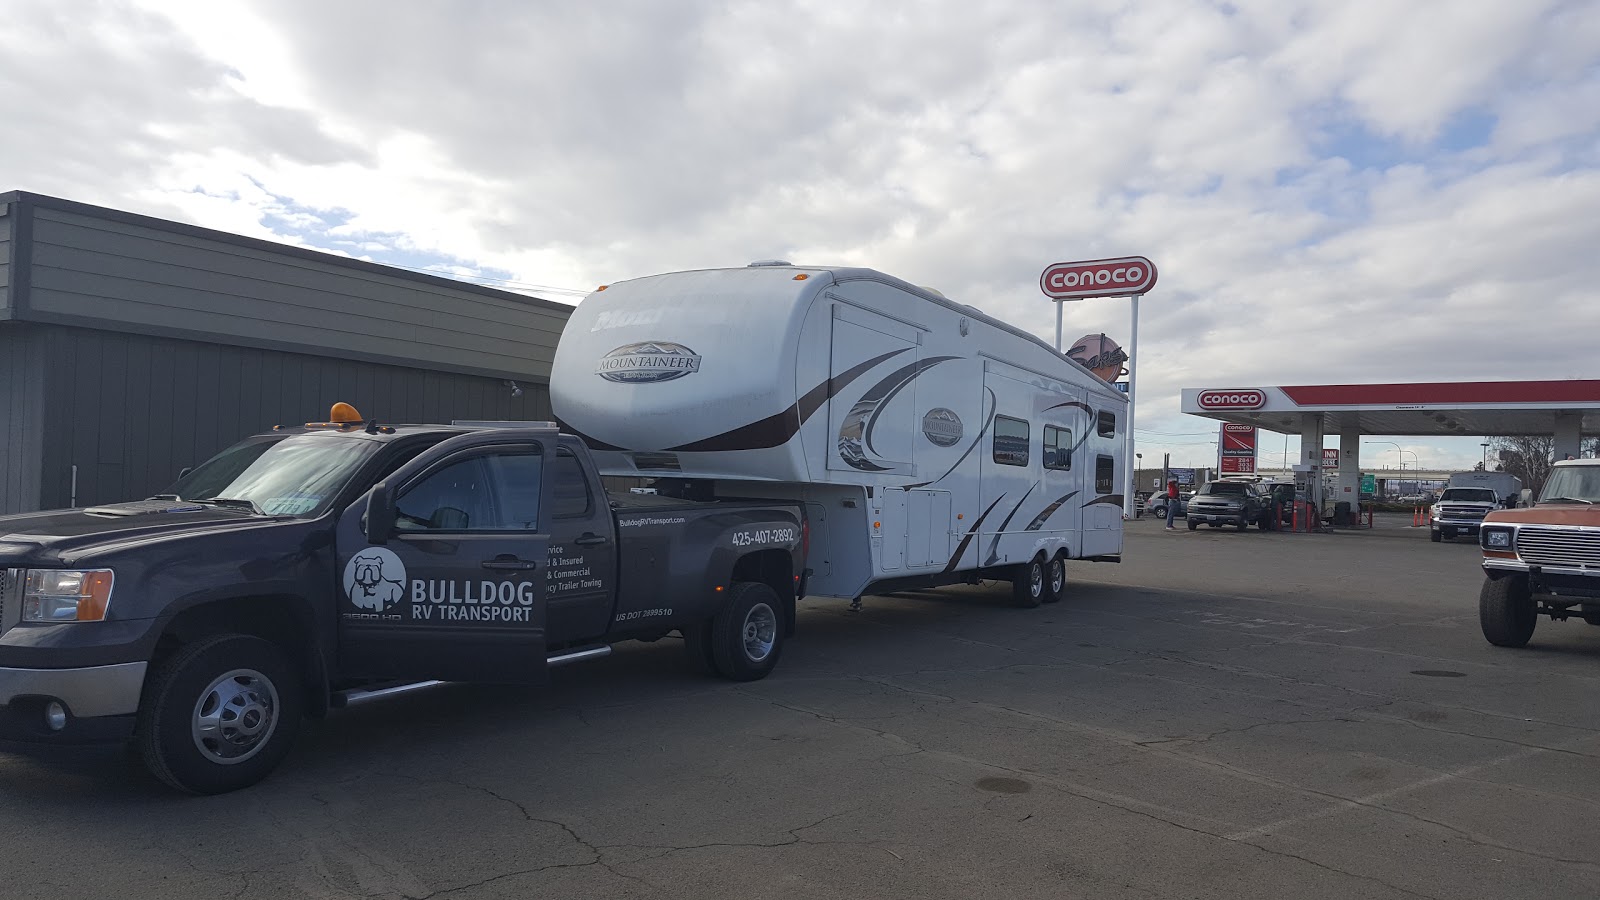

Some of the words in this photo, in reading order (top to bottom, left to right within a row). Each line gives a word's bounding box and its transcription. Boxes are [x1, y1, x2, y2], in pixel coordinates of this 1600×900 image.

[599, 356, 694, 370] MOUNTAINEER
[923, 420, 962, 436] MOUNTAINEER
[1324, 450, 1337, 458] INN
[620, 517, 686, 527] BulldogRVTransport.com
[732, 528, 794, 546] 425-407-2892
[552, 557, 557, 567] &
[559, 555, 584, 566] Insured
[553, 567, 591, 579] Commercial
[558, 576, 580, 591] Trailer
[580, 574, 602, 588] Towing
[411, 579, 534, 606] BULLDOG
[412, 604, 433, 620] RV
[438, 605, 532, 622] TRANSPORT
[616, 613, 626, 622] US
[626, 610, 643, 620] DOT
